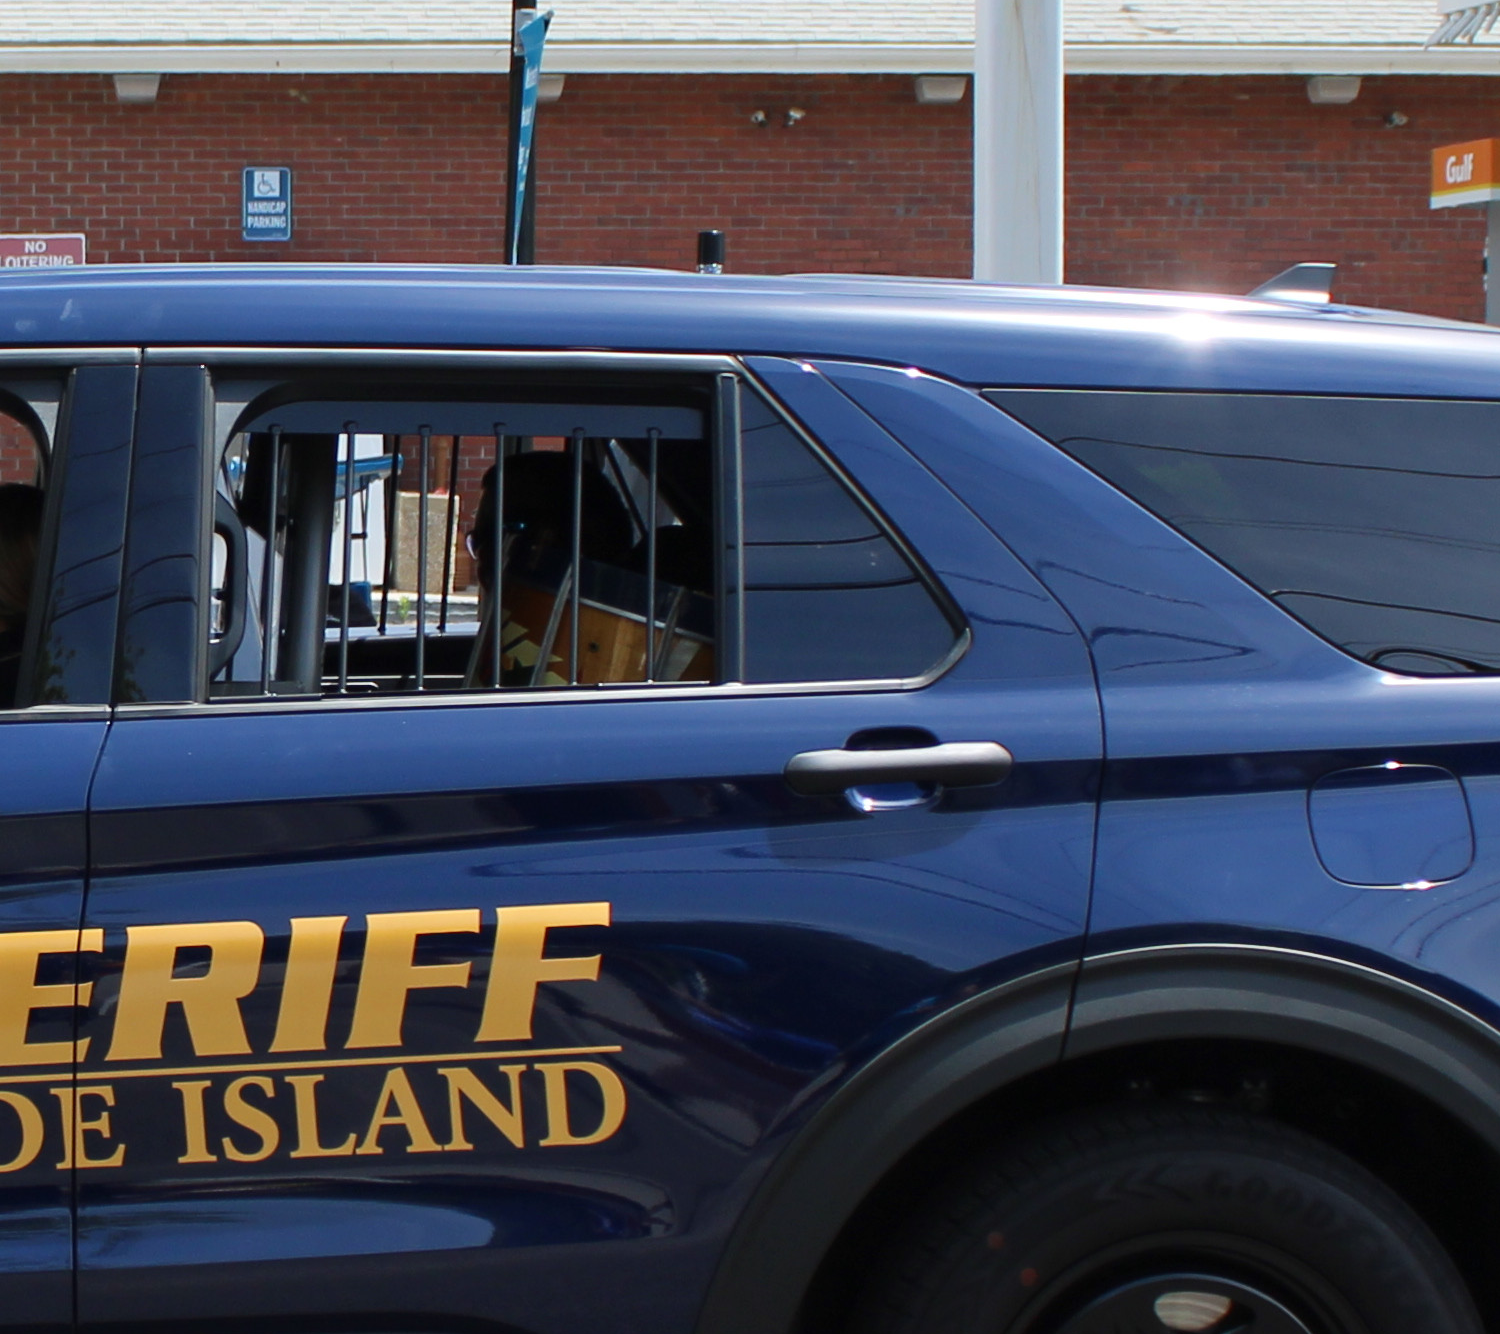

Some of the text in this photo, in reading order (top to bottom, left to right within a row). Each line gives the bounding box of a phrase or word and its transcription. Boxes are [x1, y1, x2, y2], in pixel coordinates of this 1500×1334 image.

[1445, 154, 1474, 184] Gulf
[247, 201, 287, 214] HANDICAP
[247, 216, 287, 229] PARKING
[24, 241, 47, 253] NO
[172, 1060, 627, 1163] ISLAND
